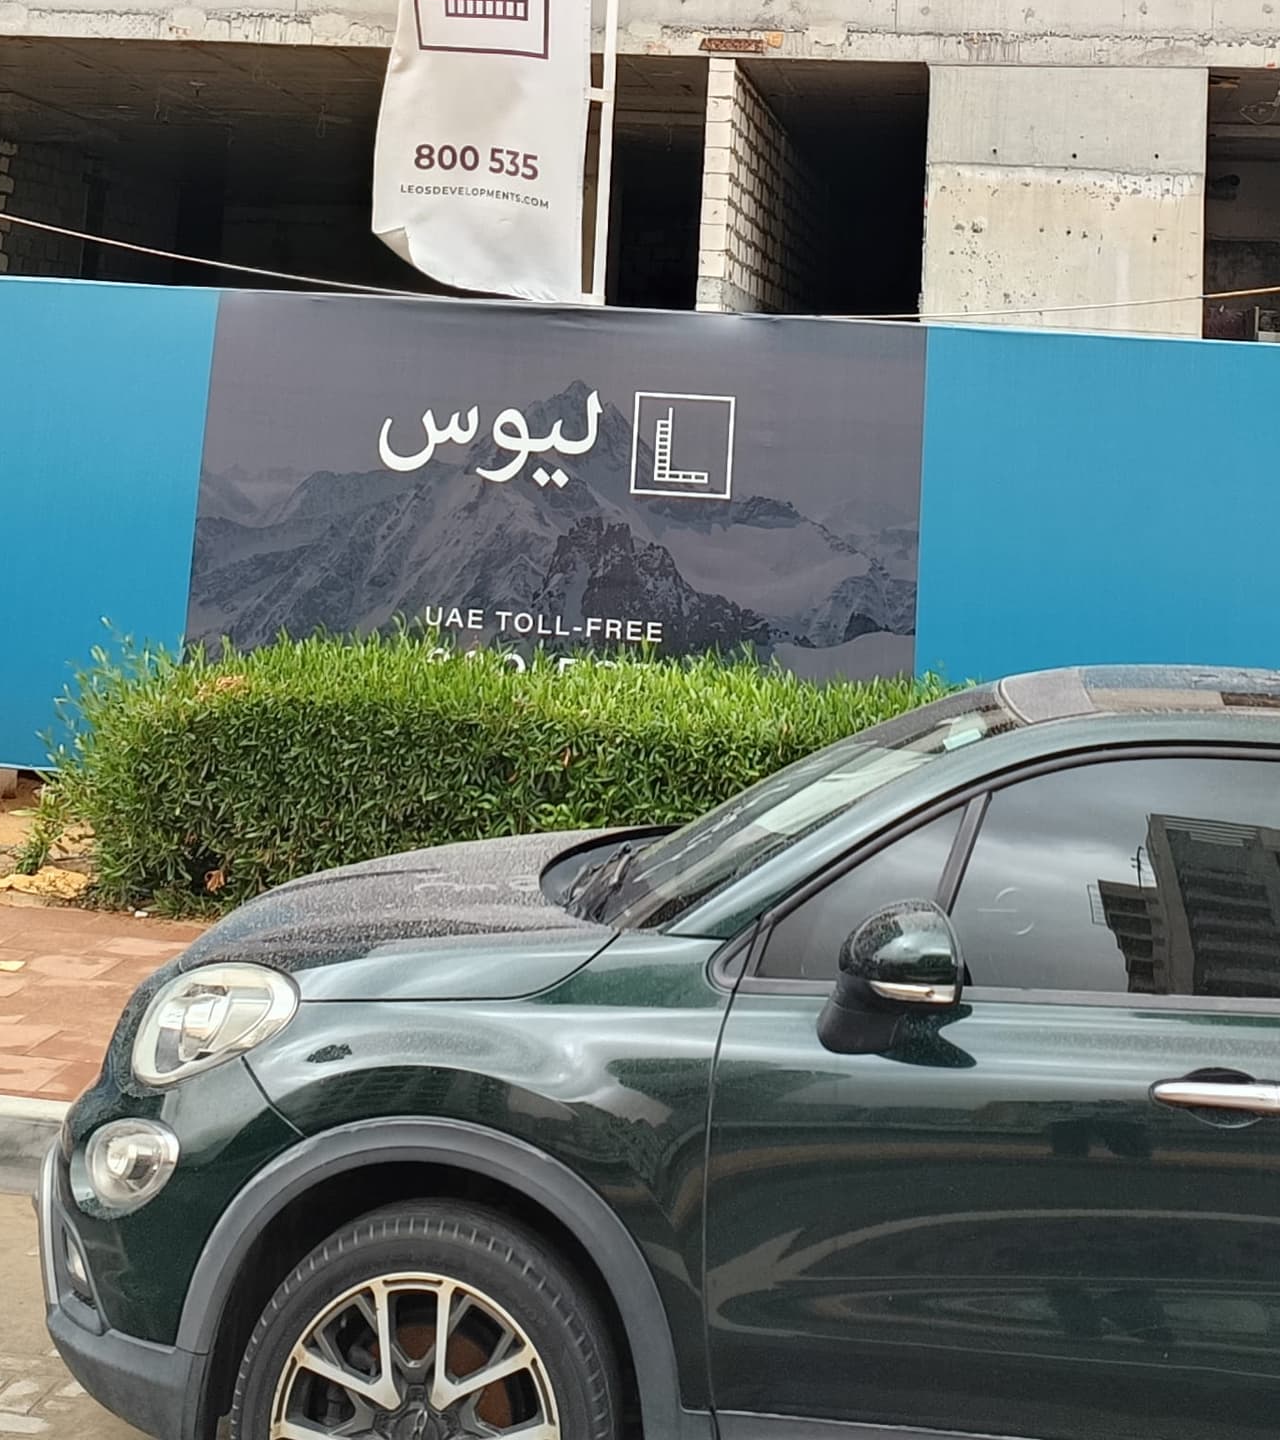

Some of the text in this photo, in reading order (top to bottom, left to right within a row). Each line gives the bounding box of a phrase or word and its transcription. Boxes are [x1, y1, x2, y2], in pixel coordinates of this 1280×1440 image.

[414, 144, 539, 180] 800 535
[400, 184, 549, 210] LEOSDEVELOPMENTS.COM
[378, 390, 603, 489] ليوس
[425, 605, 664, 643] UAE TOLL-FREE
